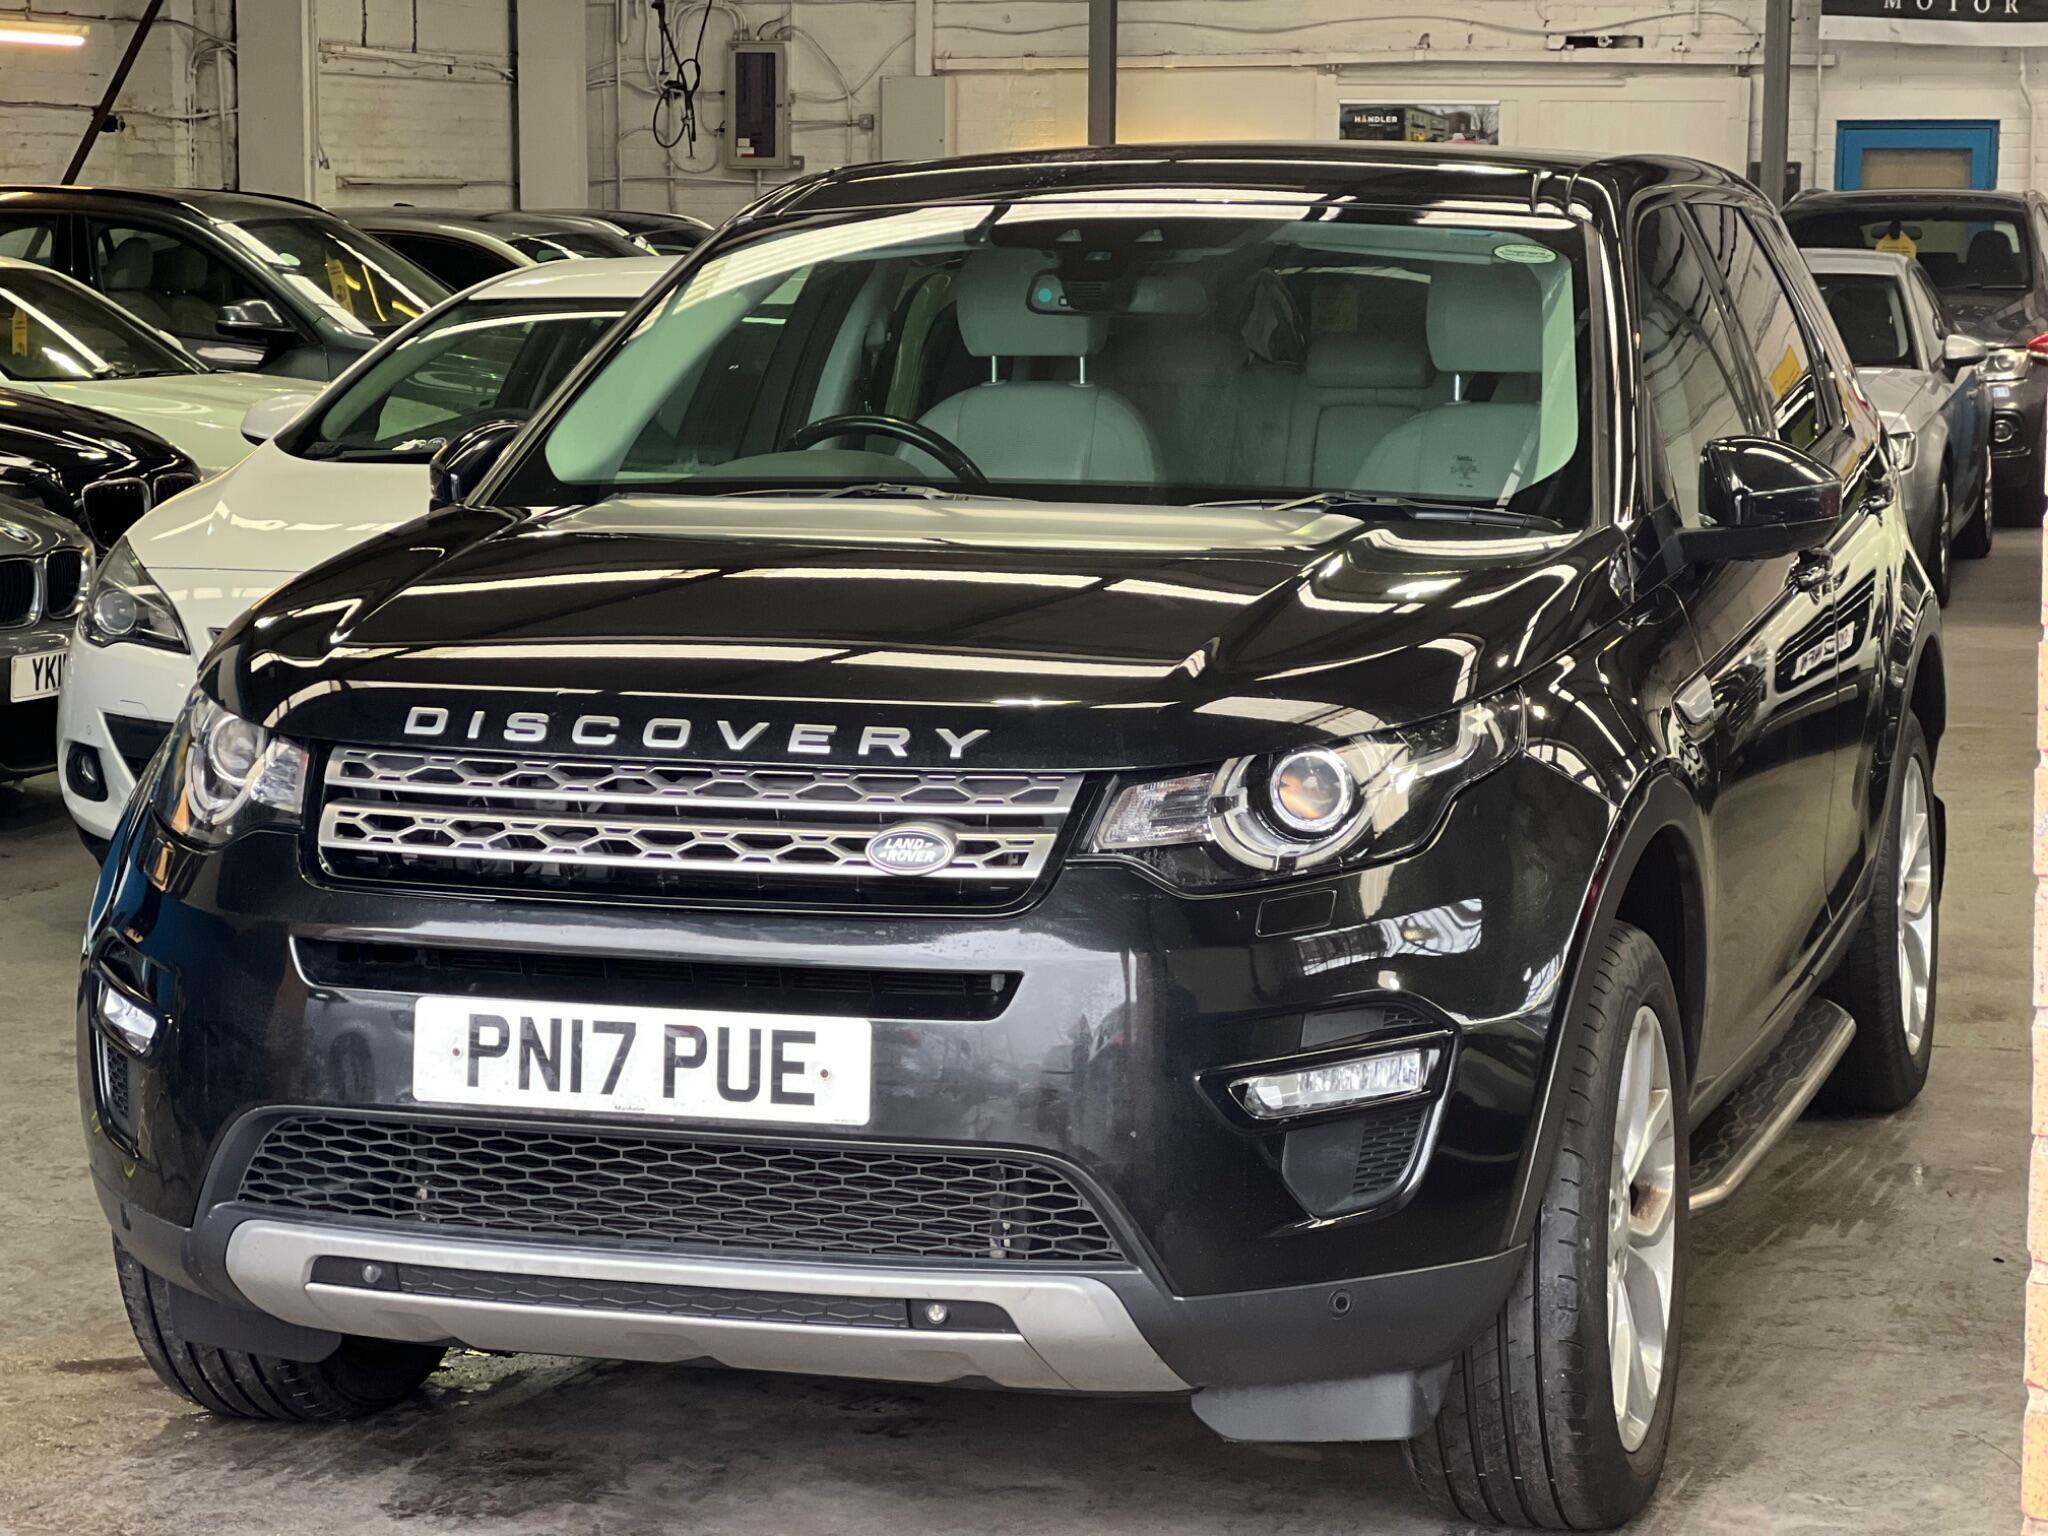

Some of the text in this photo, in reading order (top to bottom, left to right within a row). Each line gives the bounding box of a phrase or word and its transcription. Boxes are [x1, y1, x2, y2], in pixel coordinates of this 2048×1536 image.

[32, 653, 67, 691] YK1
[403, 706, 990, 758] DISCOVERY
[884, 837, 924, 850] LAND
[886, 849, 937, 863] ROVER
[466, 1013, 816, 1106] PN17 PUE
